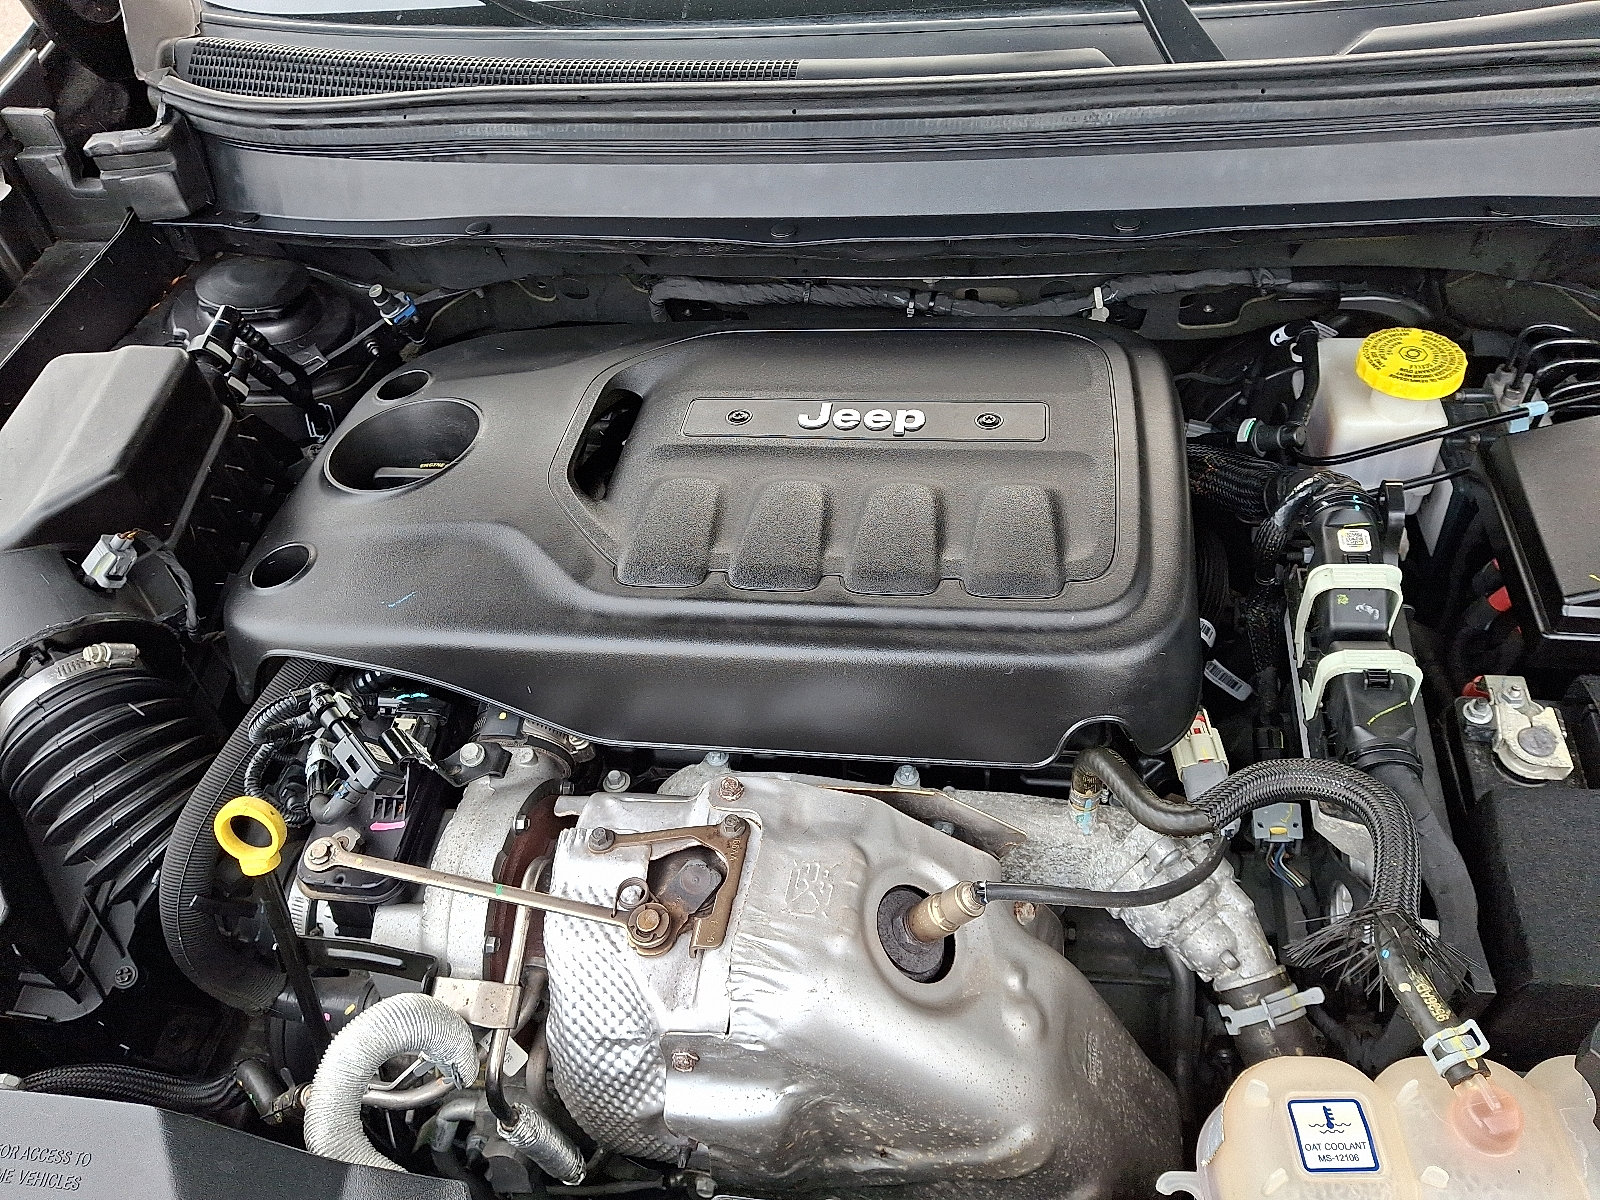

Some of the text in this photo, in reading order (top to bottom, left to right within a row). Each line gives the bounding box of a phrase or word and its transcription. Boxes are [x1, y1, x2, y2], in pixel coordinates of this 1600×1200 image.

[797, 402, 927, 437] Jeep
[20, 1146, 73, 1165] ACCESS
[75, 1151, 92, 1168] TO
[1304, 1141, 1367, 1152] OAT COOLANT
[1317, 1153, 1360, 1163] MS-12106
[19, 1169, 82, 1192] VEHICLES
